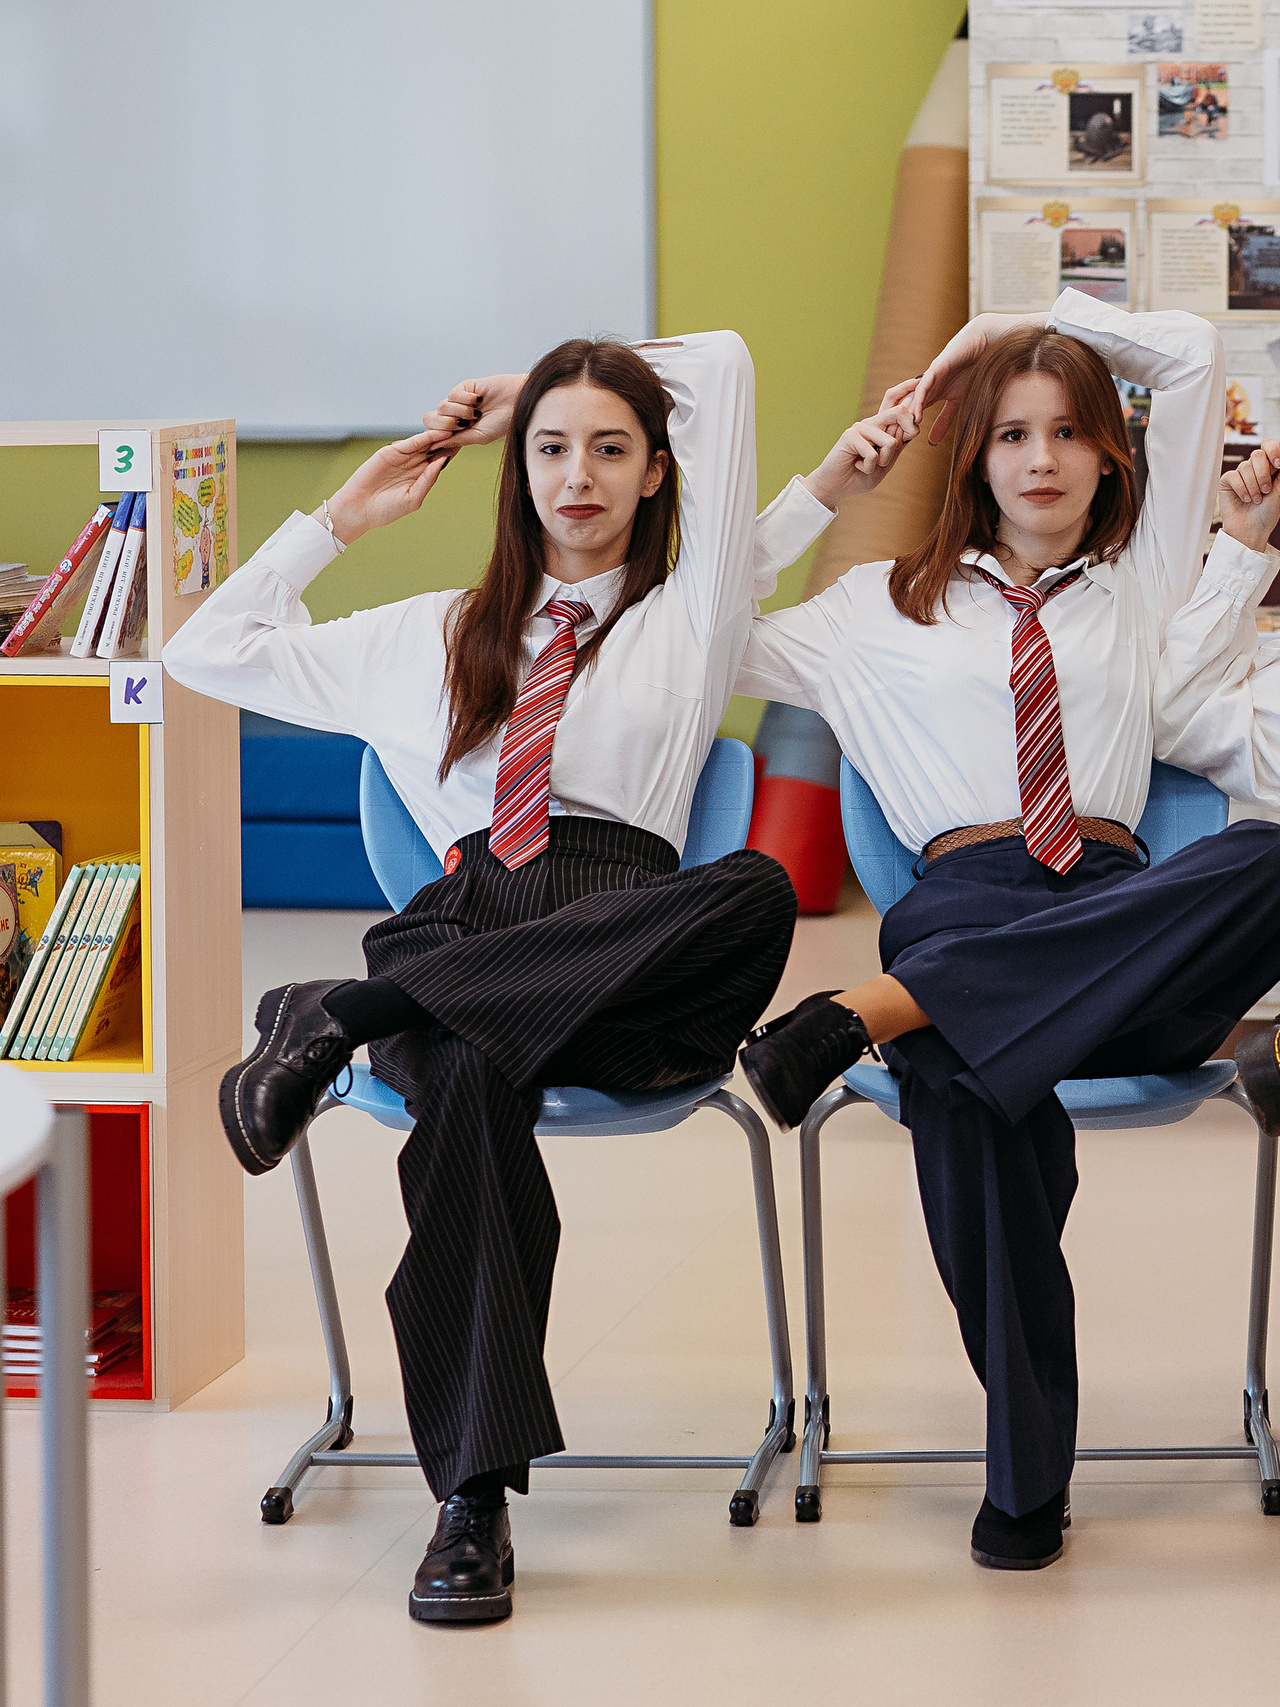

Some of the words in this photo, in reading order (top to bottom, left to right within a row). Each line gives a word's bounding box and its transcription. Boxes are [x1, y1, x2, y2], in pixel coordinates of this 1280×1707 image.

[87, 585, 100, 616] РАССКАЗЫ
[102, 550, 112, 570] ДЕТЕЙ
[113, 586, 124, 616] РАССКАЗЫ
[125, 549, 133, 570] ДЕТЕЙ
